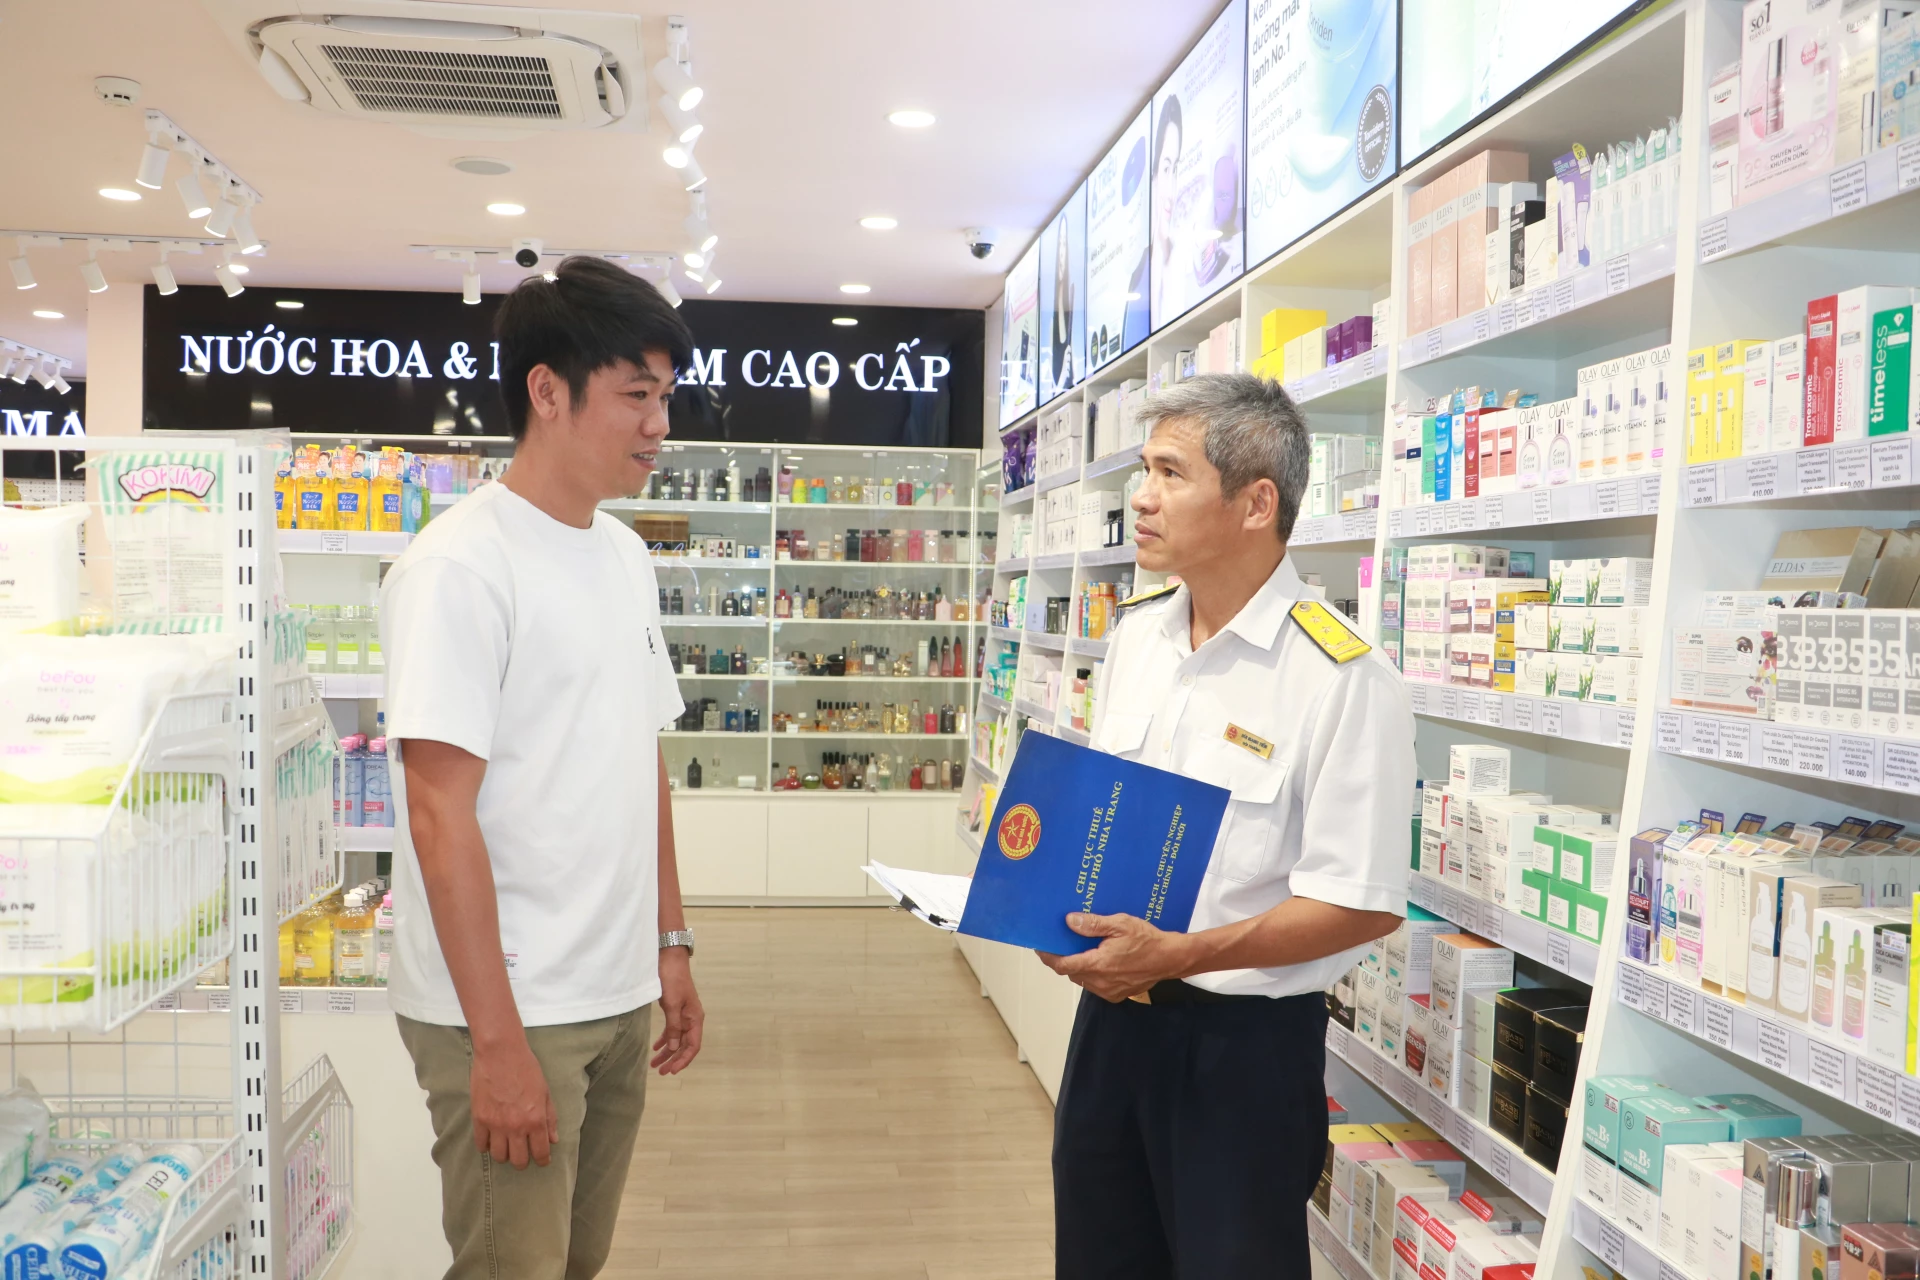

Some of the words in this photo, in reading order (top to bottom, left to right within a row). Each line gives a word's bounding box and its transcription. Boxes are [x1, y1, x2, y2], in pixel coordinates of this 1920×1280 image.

[1252, 15, 1281, 56] dưỡng
[1251, 56, 1270, 89] lạnh
[1271, 31, 1291, 67] No.1
[1769, 155, 1792, 170] KHUYÊN
[1770, 147, 1792, 161] CHUYÊN
[1461, 189, 1482, 208] ELDAS
[1436, 205, 1453, 221] ELDAS
[1411, 219, 1428, 235] ELDAS
[180, 324, 316, 376] NƯỚC
[330, 337, 433, 379] HOA
[443, 340, 479, 381] &
[1651, 347, 1672, 364] OLAY
[741, 348, 840, 390] CAO
[854, 337, 951, 393] CẤP
[1600, 360, 1621, 378] OLAY
[1625, 353, 1647, 371] OLAY
[1579, 367, 1598, 383] OLAY
[1870, 325, 1888, 424] timeless
[1835, 357, 1844, 433] Tranexamic
[1426, 397, 1436, 412] 25
[1548, 400, 1572, 419] OLAY
[1804, 374, 1813, 438] Tranexamic
[1519, 407, 1542, 425] OLAY
[1654, 416, 1666, 426] AHA
[1577, 430, 1594, 440] VITAMIN
[1599, 426, 1617, 436] VITAMIN
[1624, 421, 1642, 431] VITAMIN
[124, 467, 209, 496] KOKIMI
[1752, 488, 1774, 497] 410.000
[1771, 562, 1806, 573] ELDAS
[1777, 635, 1802, 670] B3
[1804, 636, 1832, 672] B3
[1834, 637, 1864, 673] B5
[1869, 639, 1901, 677] B5
[1872, 700, 1897, 708] HYDRATION
[26, 713, 52, 724] Bông
[55, 713, 69, 724] tẩy
[72, 713, 96, 723] trang
[1725, 749, 1744, 759] 35.000
[1767, 755, 1790, 767] 175.000
[1799, 761, 1824, 772] 220.000
[1844, 768, 1867, 778] 140.000
[1088, 807, 1104, 840] THUẾ
[1081, 842, 1095, 869] CỤC
[1082, 881, 1097, 914] HÀNH
[1090, 853, 1103, 880] PHỐ
[1097, 825, 1111, 852] NHA
[1105, 781, 1123, 823] TRANG
[1148, 883, 1160, 909] BẠCH
[1156, 839, 1172, 877] CHUYÊN
[1167, 804, 1182, 839] NGHIỆP
[1153, 896, 1165, 920] LIÊM
[1160, 865, 1174, 894] CHÍNH
[1175, 822, 1187, 841] MỚI
[1076, 871, 1087, 894] CHI
[1437, 940, 1456, 958] OLAY
[1874, 964, 1882, 974] 95
[1361, 970, 1377, 988] OLAY
[1385, 985, 1399, 1003] OLAY
[1450, 991, 1456, 1000] C
[1432, 1018, 1449, 1038] OLAY
[1428, 1060, 1445, 1076] VITAMIN
[1445, 1069, 1450, 1079] C
[1865, 1099, 1892, 1119] 320.000
[1598, 1123, 1610, 1144] B5
[1638, 1148, 1651, 1169] B5
